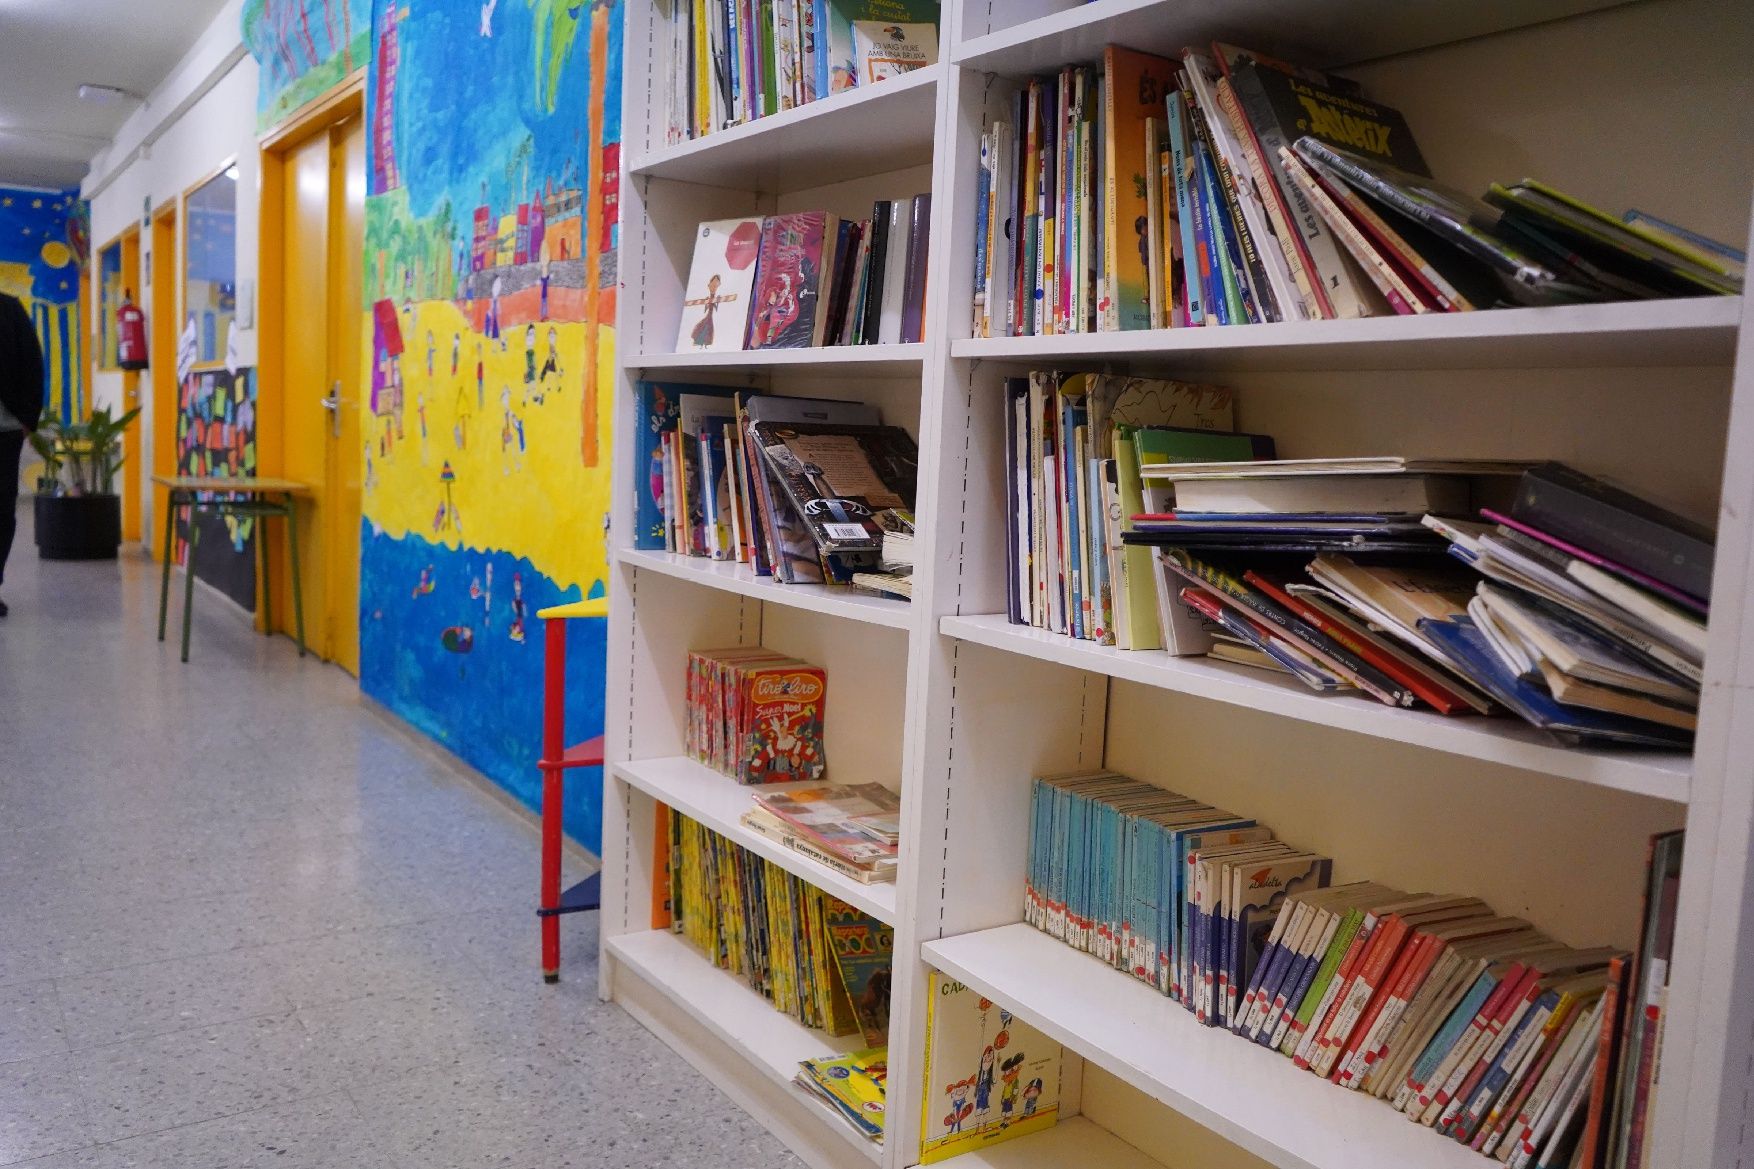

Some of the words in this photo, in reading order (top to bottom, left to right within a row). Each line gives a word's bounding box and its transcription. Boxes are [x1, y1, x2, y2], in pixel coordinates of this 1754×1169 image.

[882, 43, 900, 51] VAIG
[1194, 413, 1215, 429] Tres
[941, 982, 968, 996] CAD
